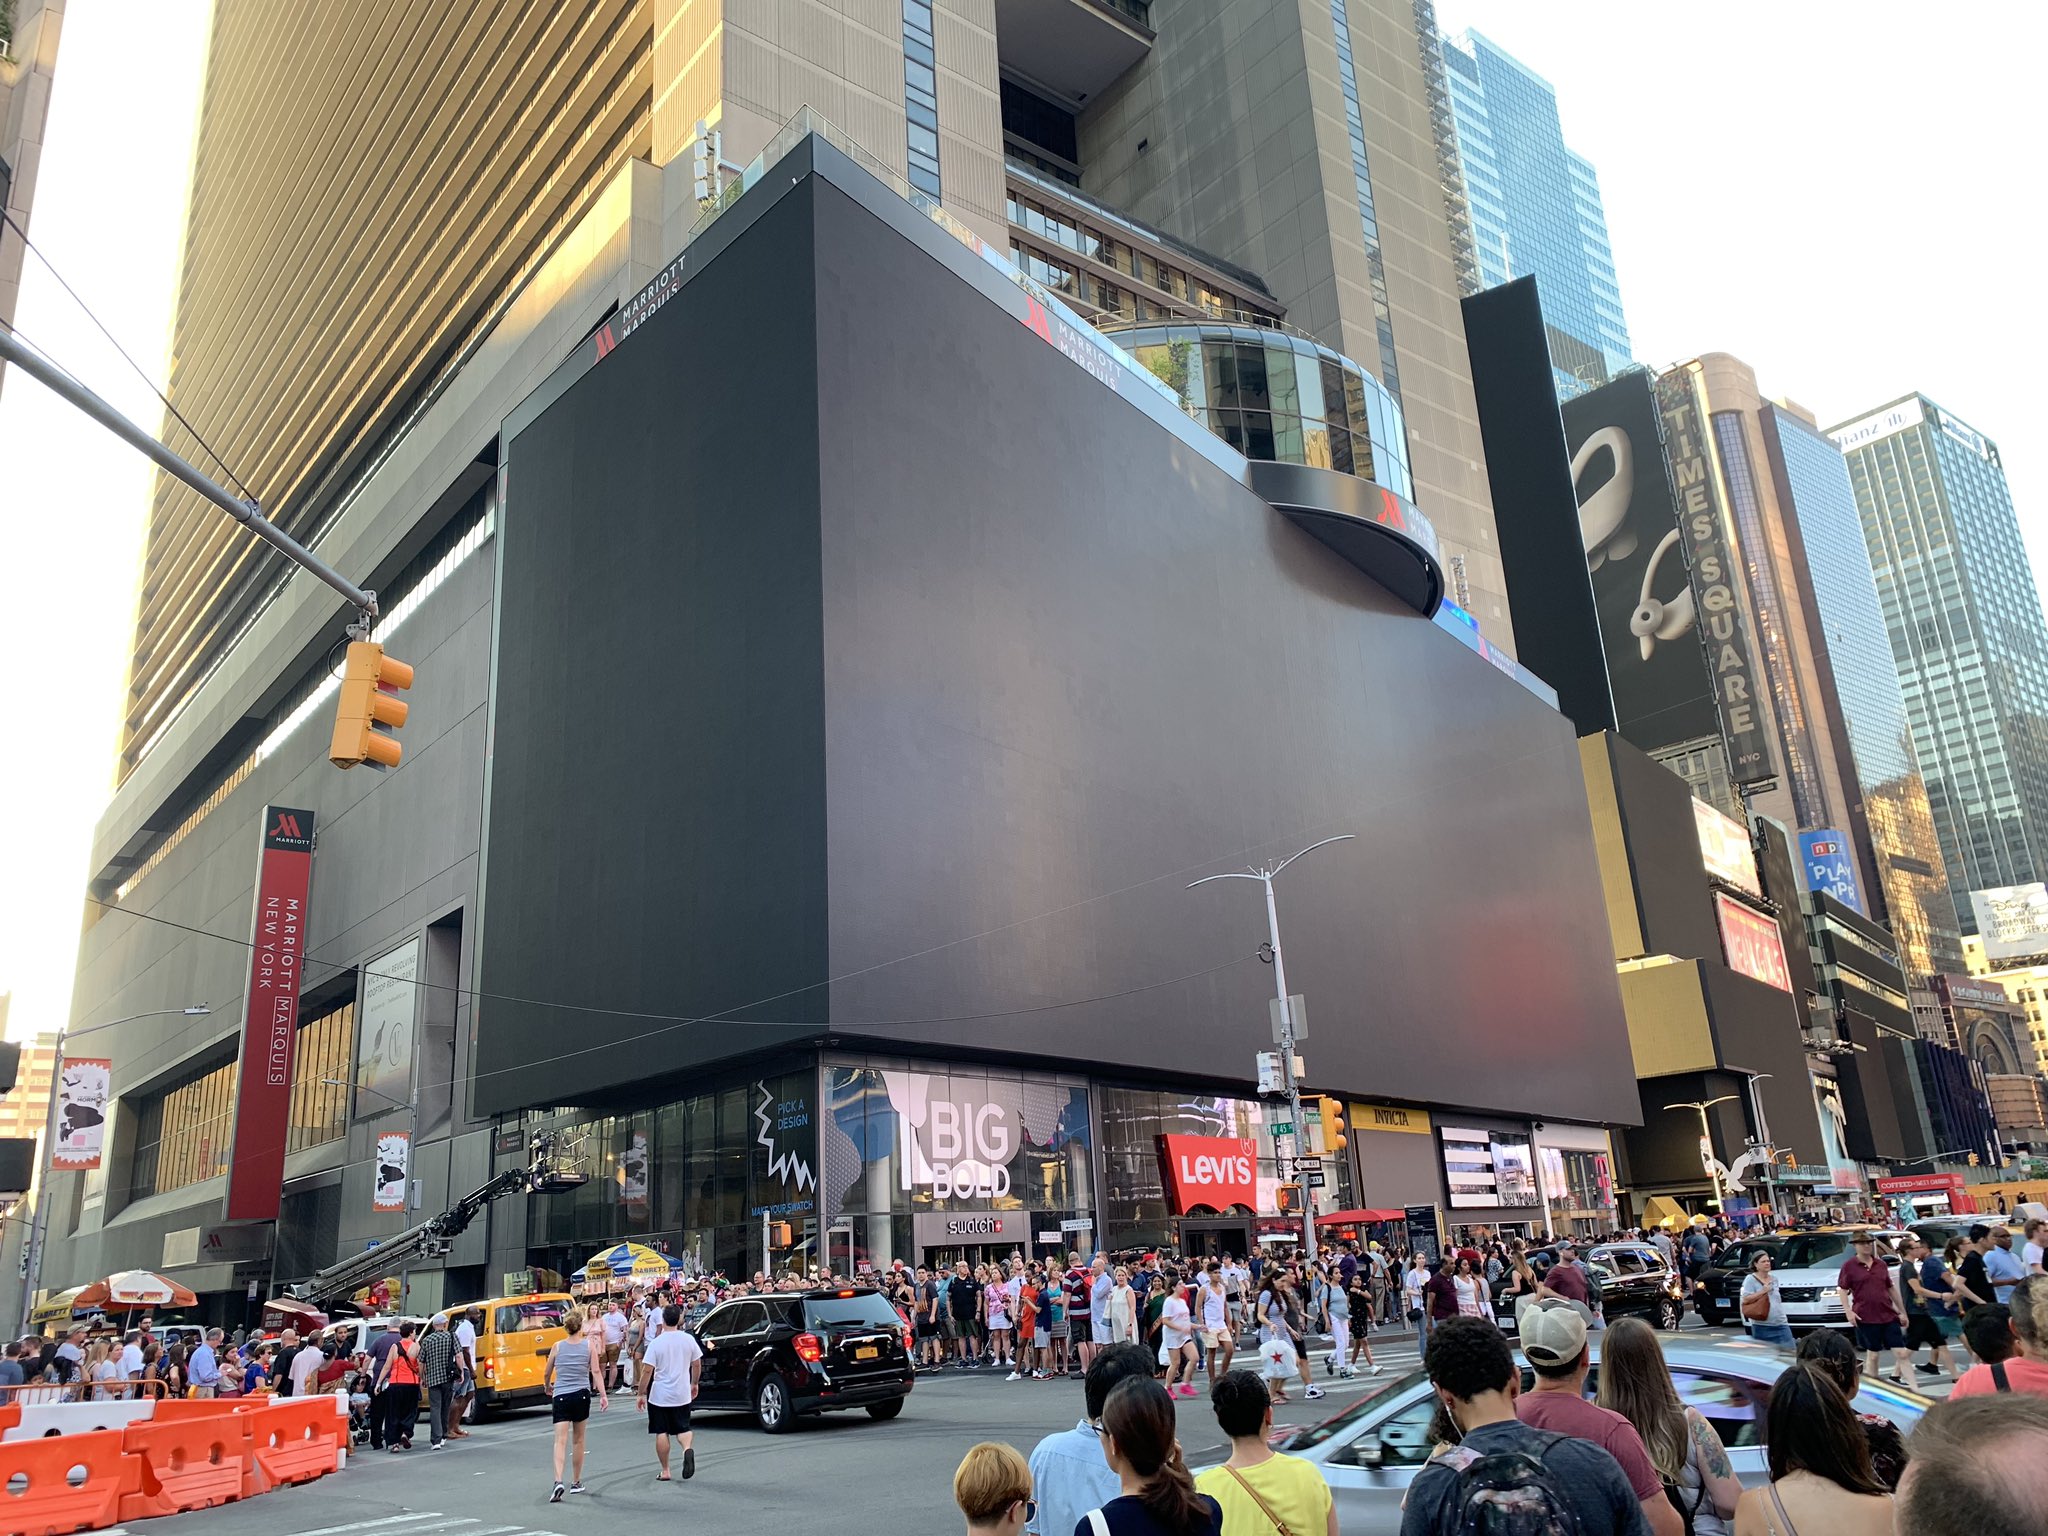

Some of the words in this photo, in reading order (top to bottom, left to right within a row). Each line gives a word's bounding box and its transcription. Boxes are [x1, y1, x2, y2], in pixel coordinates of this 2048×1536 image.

[622, 255, 686, 323] MARRIOTT
[1059, 322, 1121, 378] MARRIOTT
[1060, 341, 1116, 391] MARQUIS
[1665, 404, 1712, 541] TIMES
[1701, 556, 1754, 735] SQUARE
[1739, 752, 1760, 765] NYC
[275, 837, 310, 845] MARRIOTT
[264, 897, 280, 935] NEW
[279, 898, 299, 992] MARRIOTT
[259, 942, 277, 990] YORK
[270, 998, 290, 1083] MARQUIS
[777, 1100, 796, 1115] PICK
[798, 1099, 805, 1110] A
[777, 1113, 808, 1130] DESIGN
[1373, 1108, 1409, 1126] INVICTA
[931, 1101, 1008, 1160] BIG
[1279, 1124, 1287, 1134] 45
[932, 1162, 1011, 1199] BOLD
[770, 1203, 787, 1215] YOUR
[788, 1200, 813, 1213] SWATCH
[948, 1217, 995, 1235] swatch
[34, 1307, 69, 1320] SABRETT
